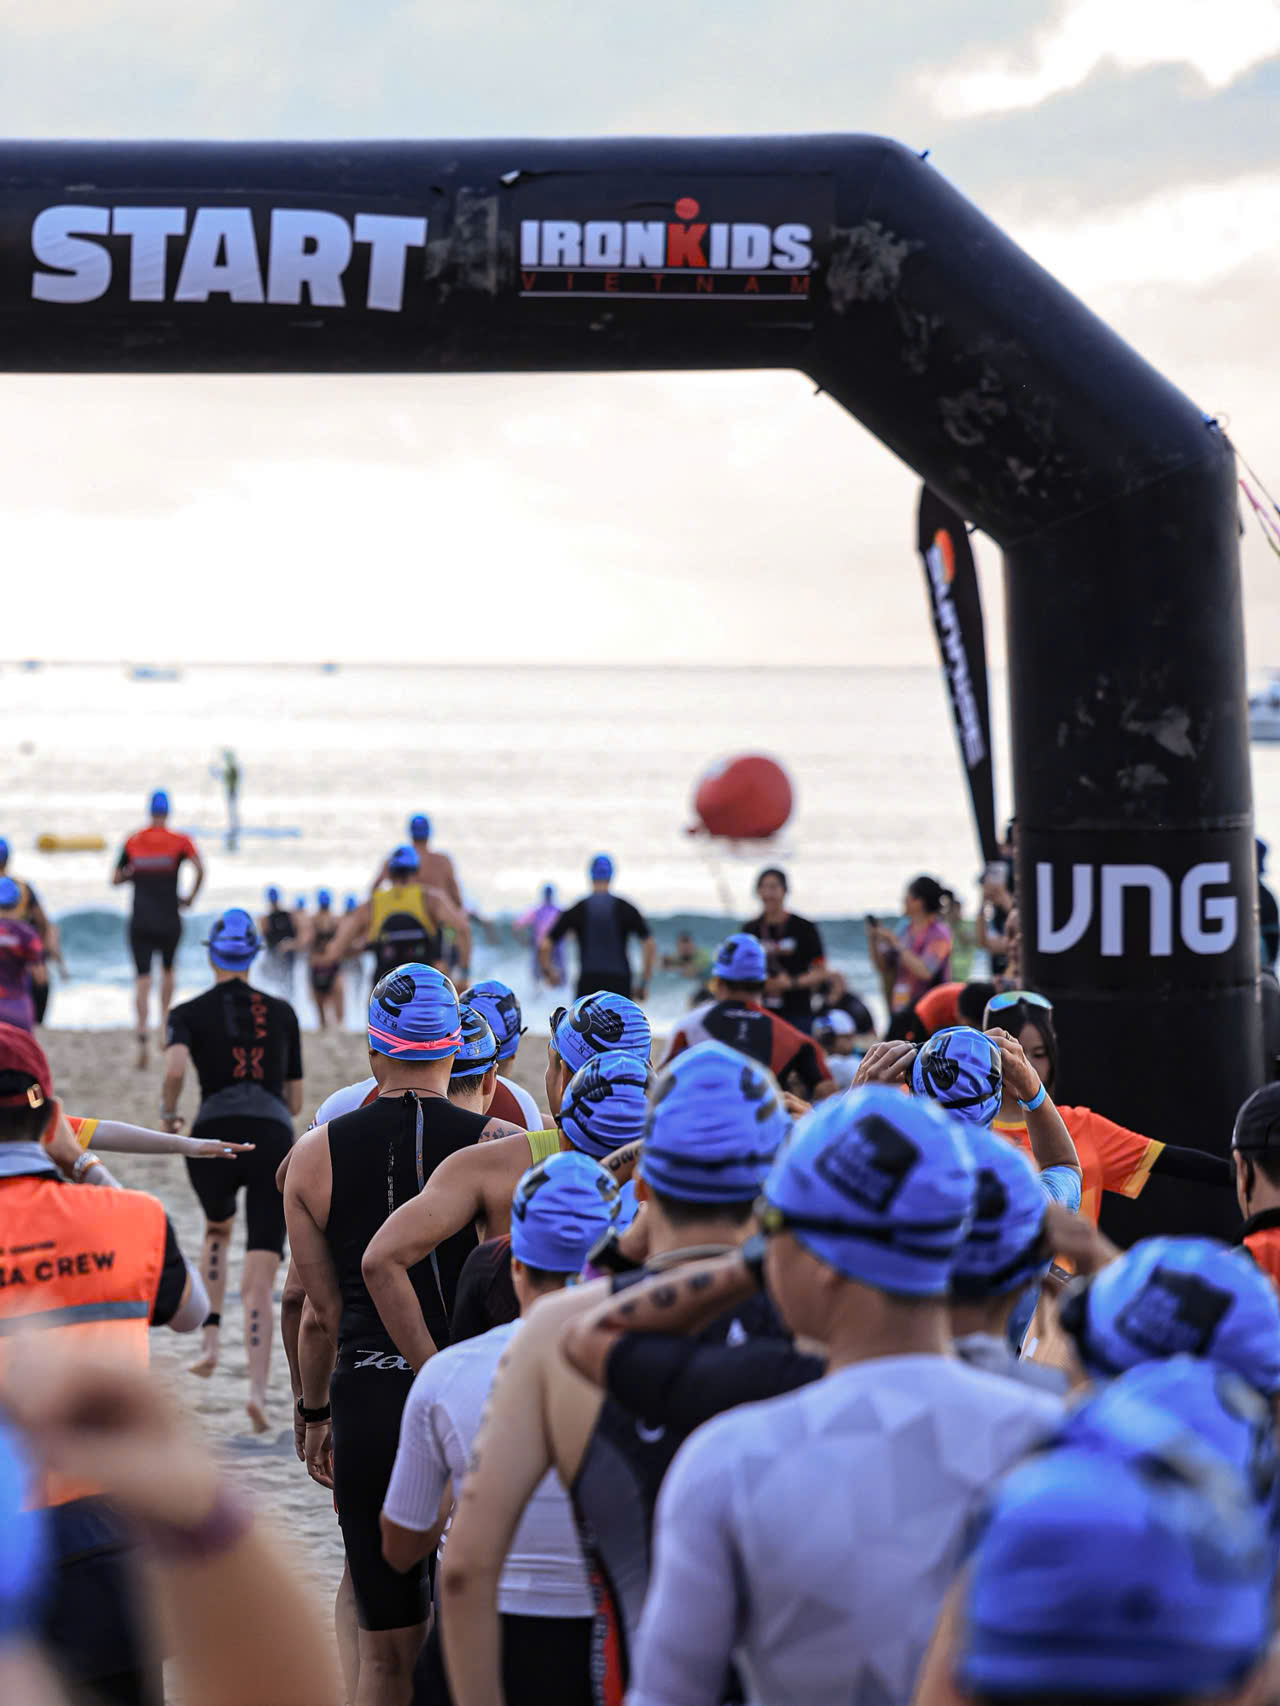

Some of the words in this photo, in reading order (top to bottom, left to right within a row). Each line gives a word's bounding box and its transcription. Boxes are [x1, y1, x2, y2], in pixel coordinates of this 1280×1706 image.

[31, 205, 427, 312] START
[520, 198, 813, 271] IRONKIDS
[1036, 861, 1238, 957] VNG
[34, 1252, 115, 1282] CREW
